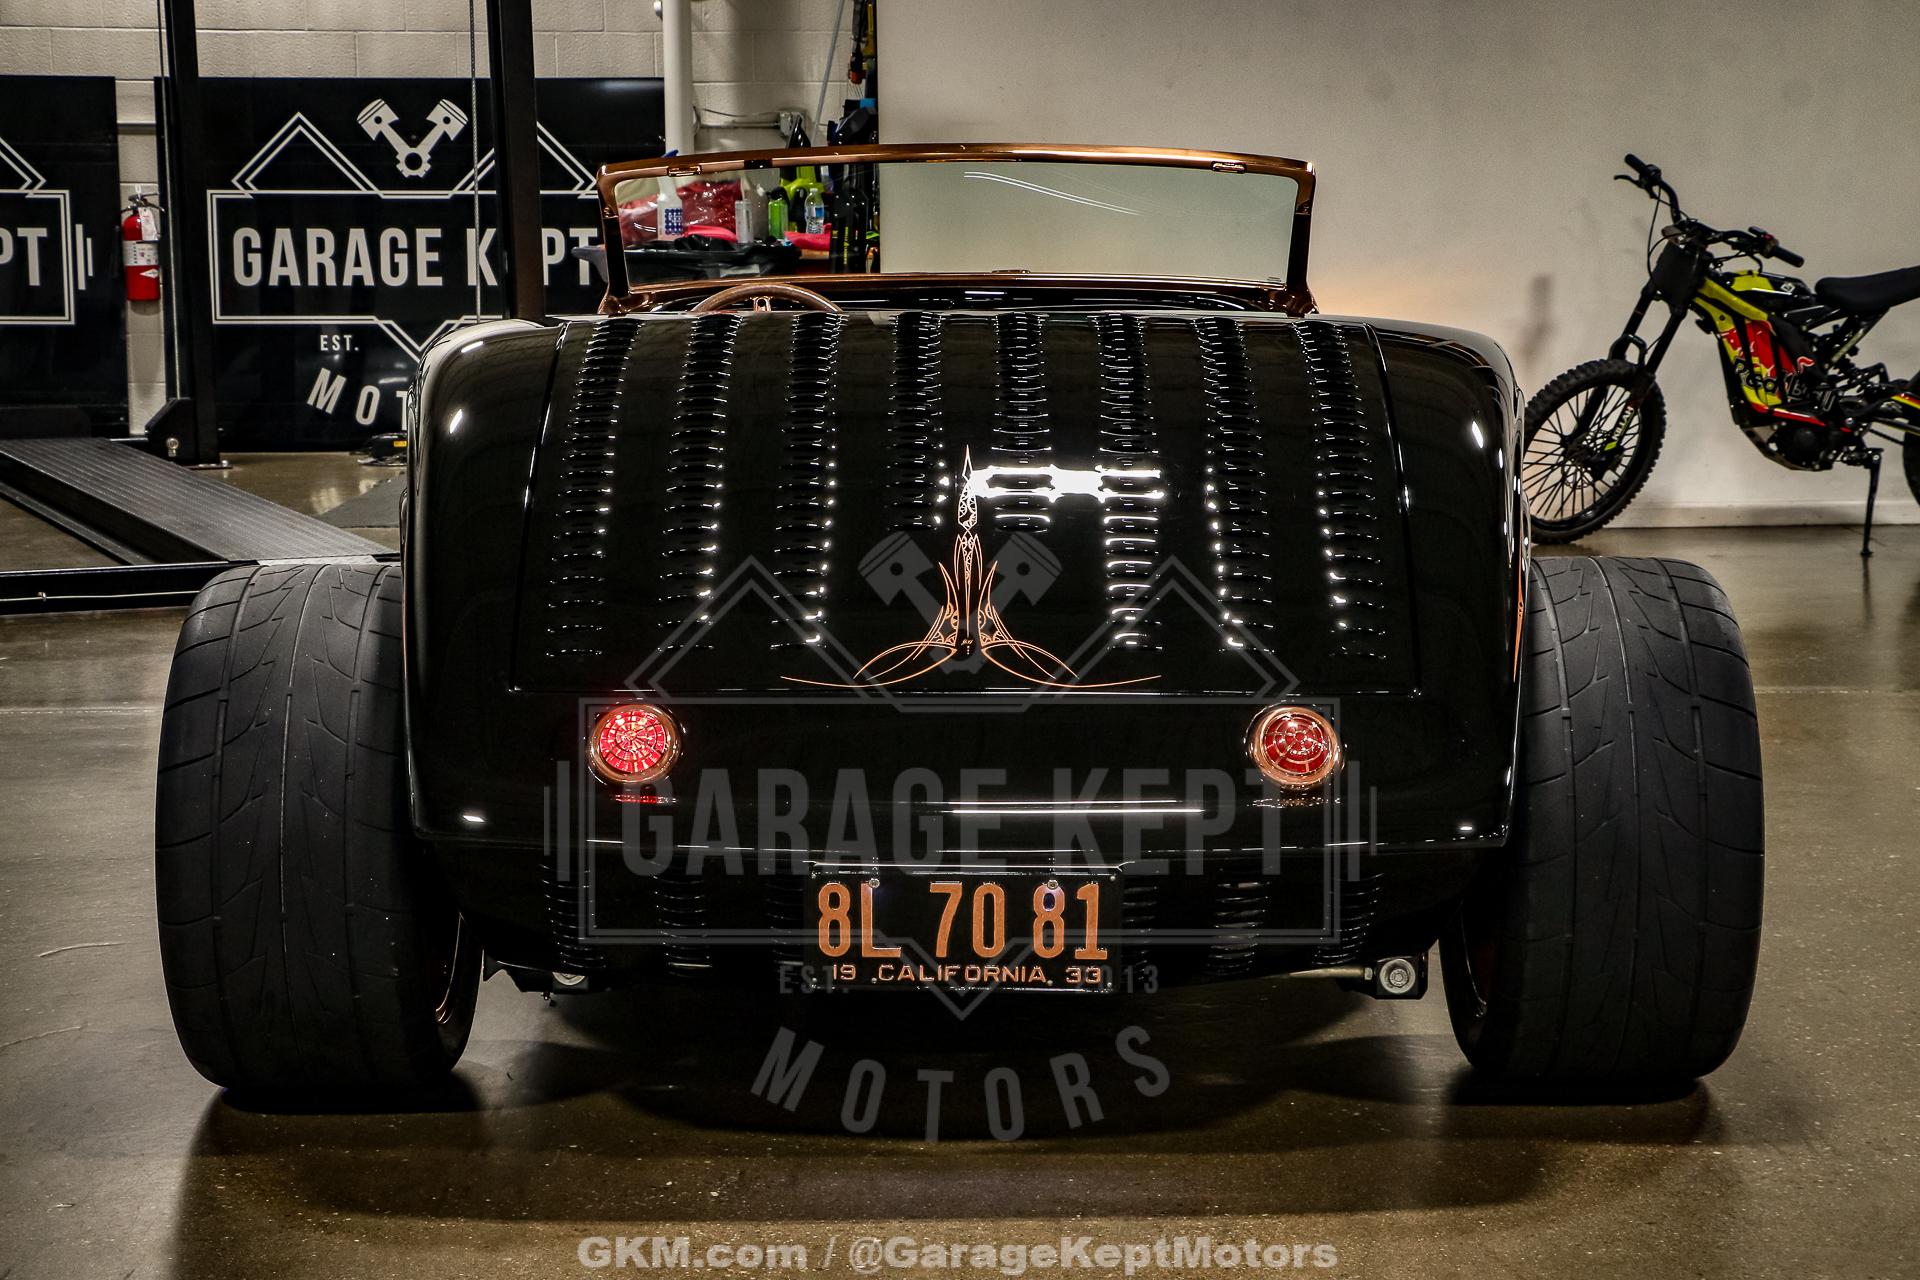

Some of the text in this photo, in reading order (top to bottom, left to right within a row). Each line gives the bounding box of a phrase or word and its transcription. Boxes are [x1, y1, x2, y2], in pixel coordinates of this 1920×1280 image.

[232, 227, 598, 287] GARAGE KPT
[320, 334, 359, 351] EST.
[818, 880, 1108, 960] 8L 70 81
[832, 963, 1102, 984] 19 CALIFORNIA 33
